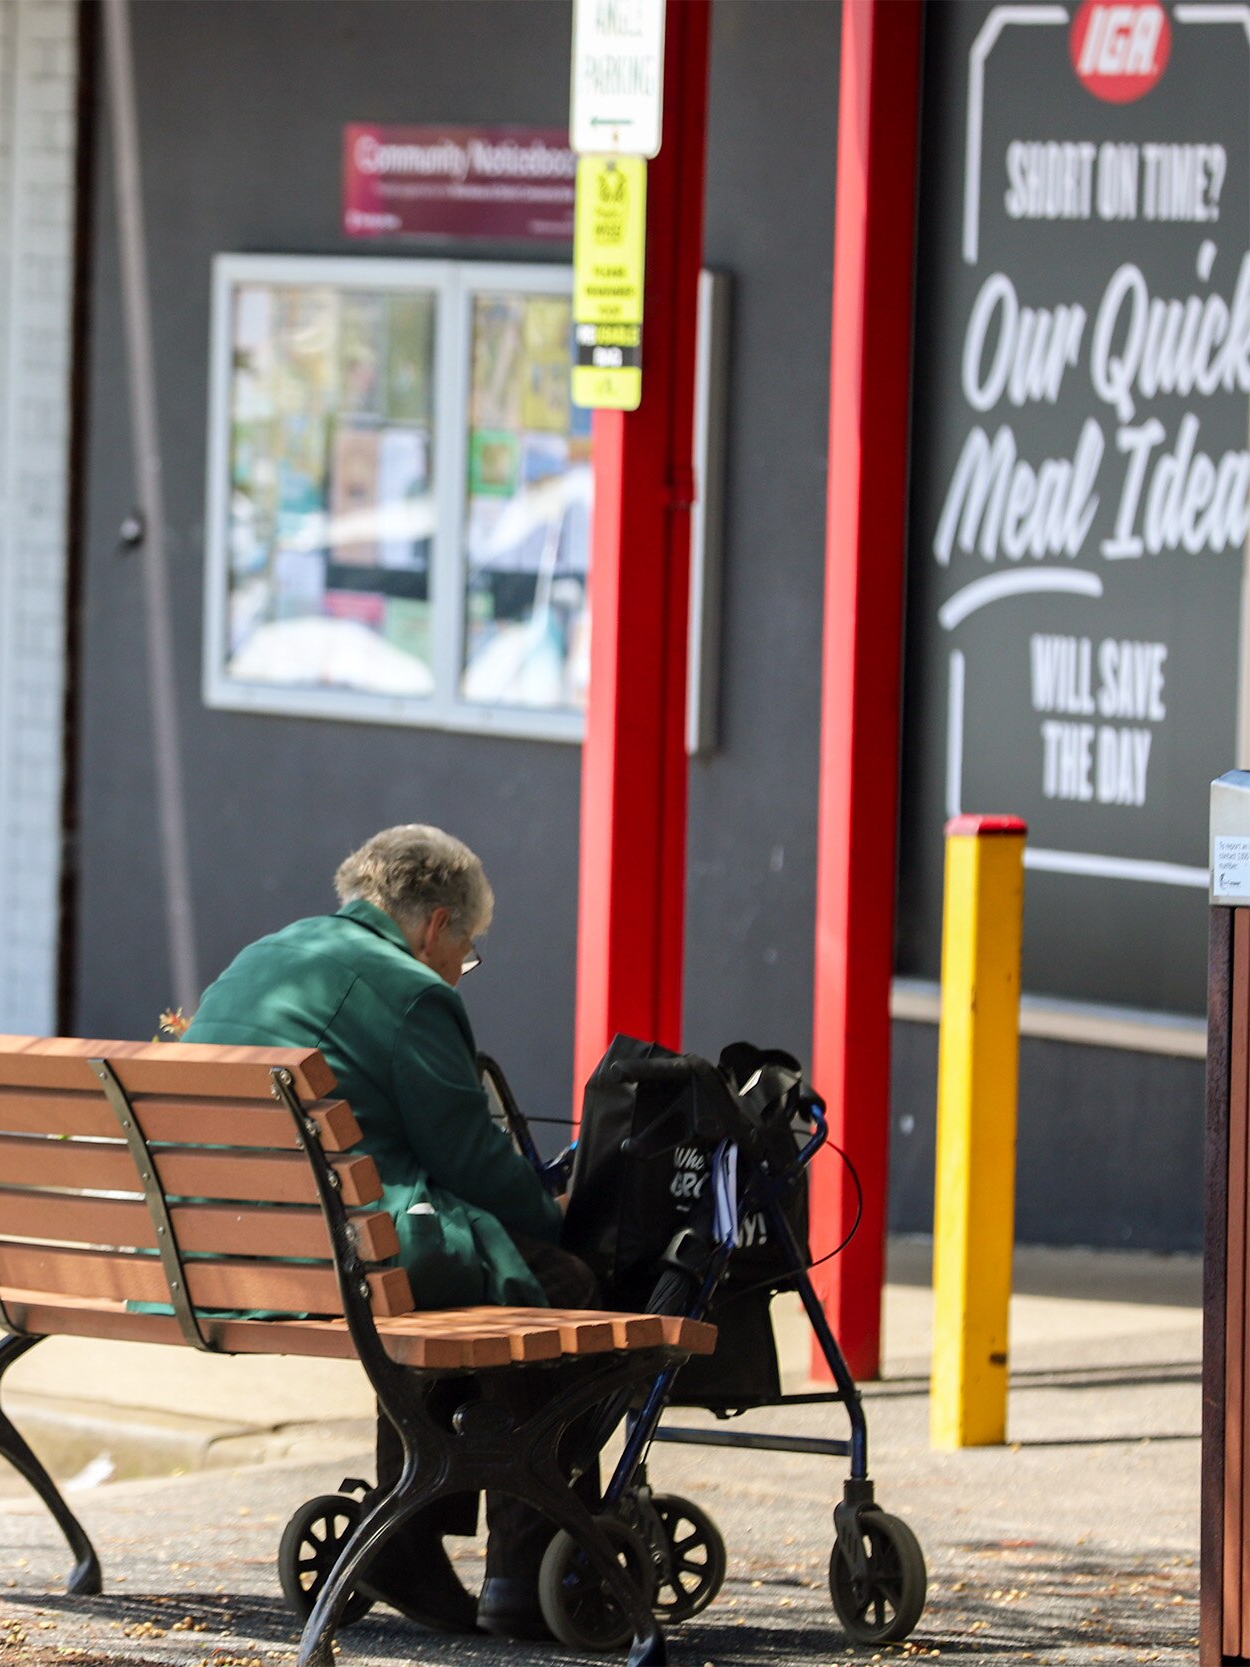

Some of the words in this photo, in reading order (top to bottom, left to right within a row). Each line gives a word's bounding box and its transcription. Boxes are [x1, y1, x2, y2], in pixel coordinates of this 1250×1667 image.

[595, 0, 643, 37] ANGLE
[1077, 5, 1166, 75] IGA
[584, 54, 655, 97] PARKING
[354, 135, 469, 183] Community
[1004, 140, 1096, 220] SHORT
[1096, 142, 1139, 220] ON
[1141, 142, 1227, 222] TIME?
[961, 271, 1087, 412] Our
[932, 416, 1105, 568] Meal
[1029, 632, 1096, 716] WILL
[1097, 637, 1168, 722] SAVE
[1040, 719, 1095, 802] THE
[1096, 725, 1152, 807] DAY
[674, 1146, 710, 1171] Whe
